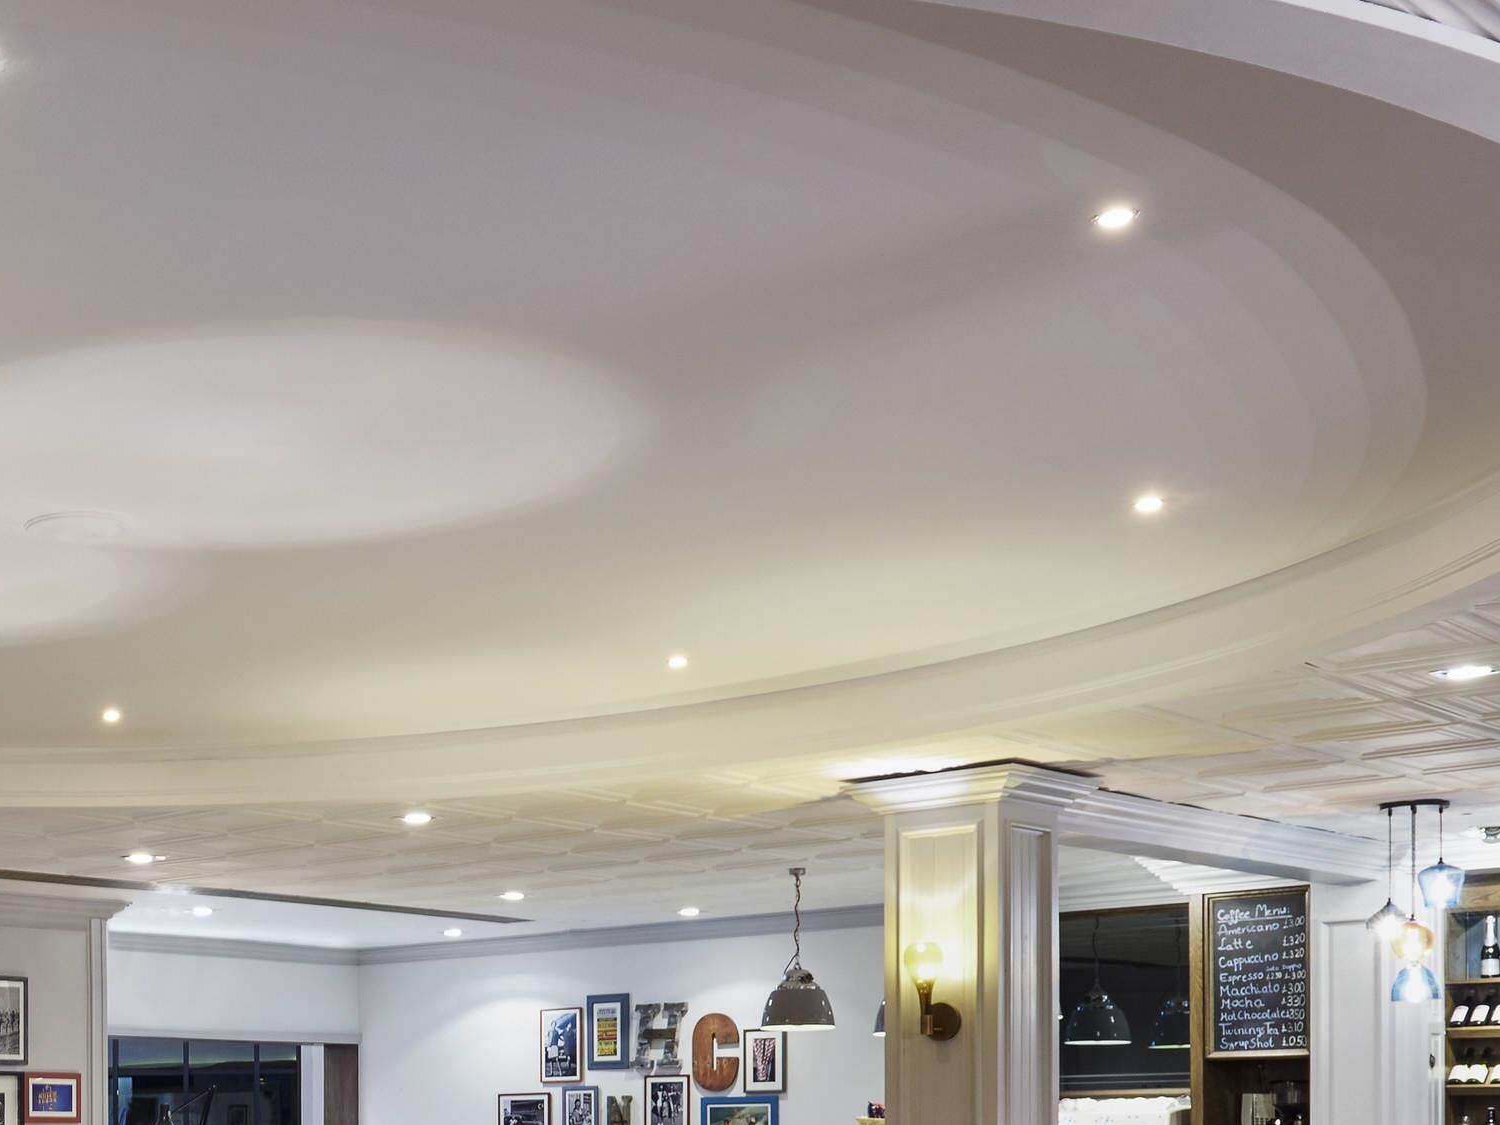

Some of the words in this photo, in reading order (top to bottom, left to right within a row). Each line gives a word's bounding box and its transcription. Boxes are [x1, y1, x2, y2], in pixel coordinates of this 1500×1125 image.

[1217, 909, 1250, 925] Coffee
[1217, 923, 1279, 936] Americano
[1217, 937, 1253, 950] Latte
[1219, 952, 1278, 971] Cappuccino
[1220, 972, 1264, 985] Espresso
[1220, 982, 1280, 997] Macchiato
[1220, 996, 1265, 1009] Mocha
[1220, 1011, 1236, 1021] Hot
[1238, 1008, 1286, 1020] Chocolate
[1219, 1022, 1264, 1037] Twinings
[1264, 1021, 1279, 1035] Tea
[632, 1002, 688, 1070] H
[692, 1013, 740, 1091] C
[1249, 1035, 1274, 1049] Shot
